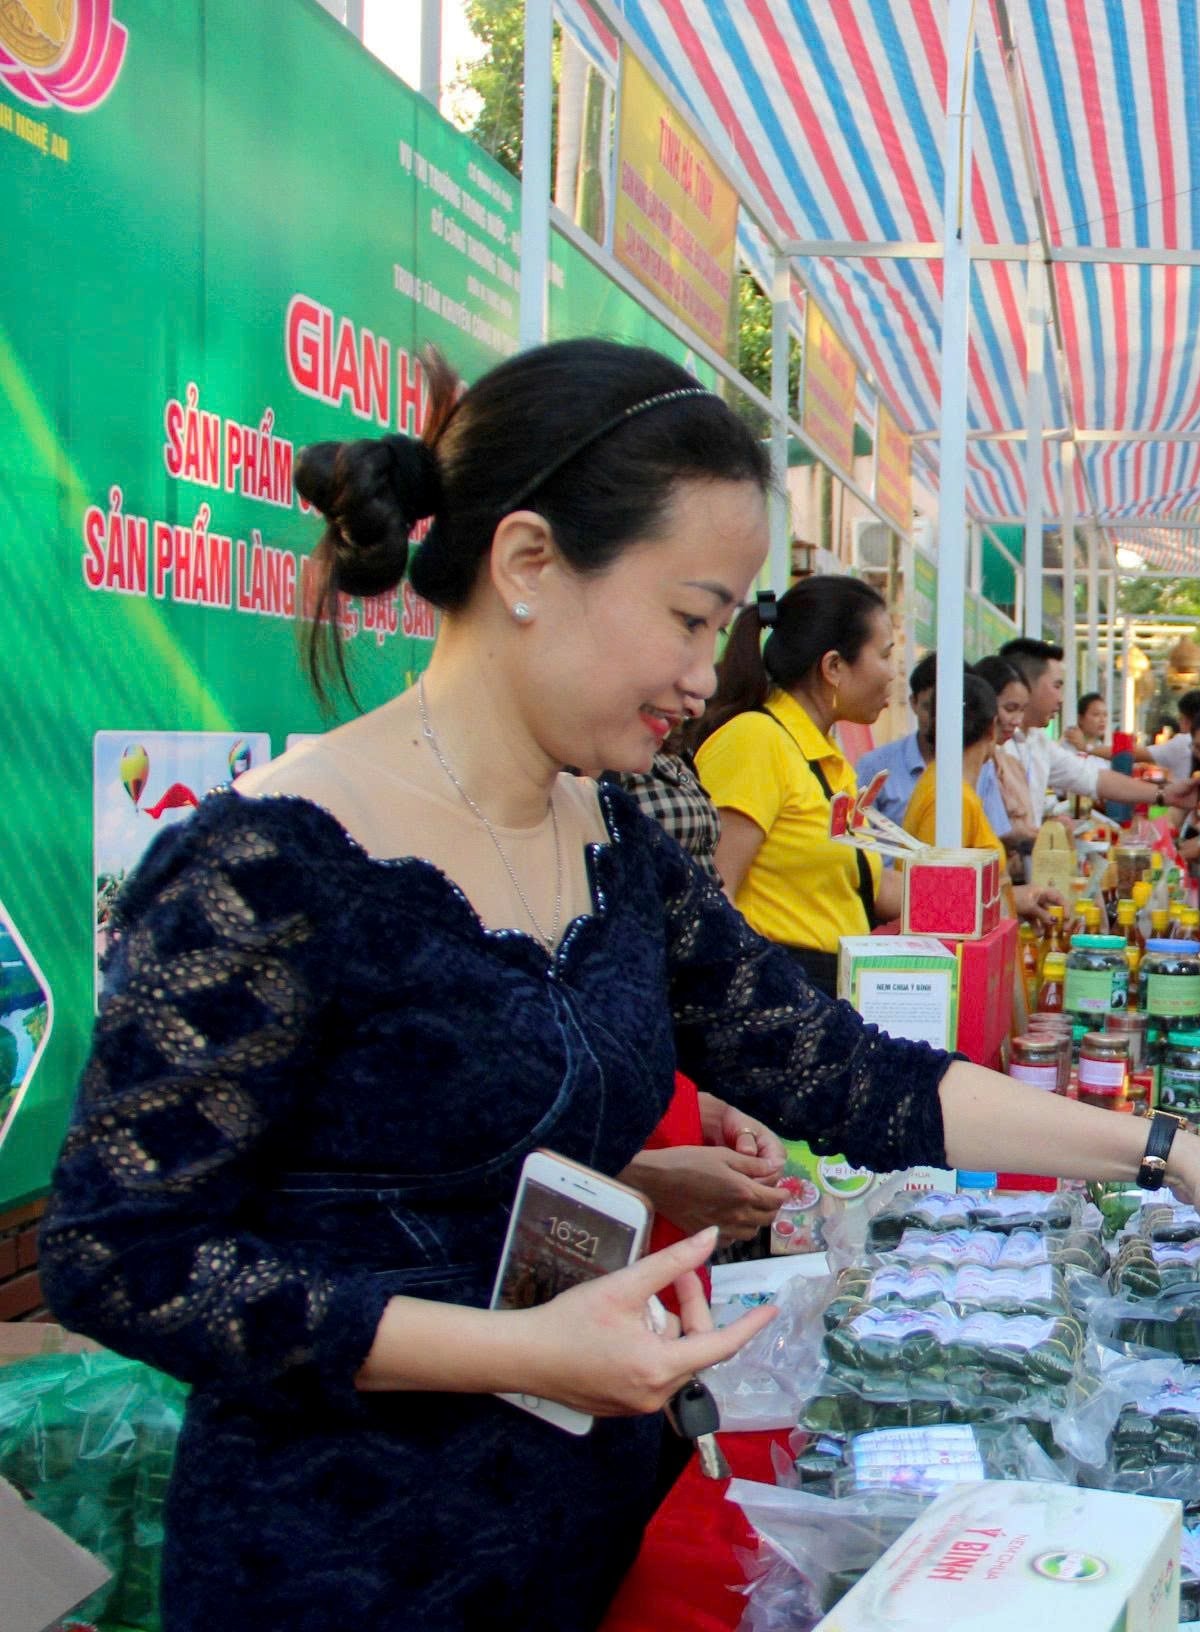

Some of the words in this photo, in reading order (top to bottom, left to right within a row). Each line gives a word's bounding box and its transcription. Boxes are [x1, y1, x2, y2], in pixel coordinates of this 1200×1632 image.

[286, 294, 390, 427] GIAN
[164, 382, 220, 489] SẢN
[225, 407, 293, 508] PHẨM
[84, 485, 149, 597] SẢN
[153, 502, 232, 608] PHẨM
[237, 529, 296, 618] LÀNG
[549, 1216, 599, 1255] 16:21
